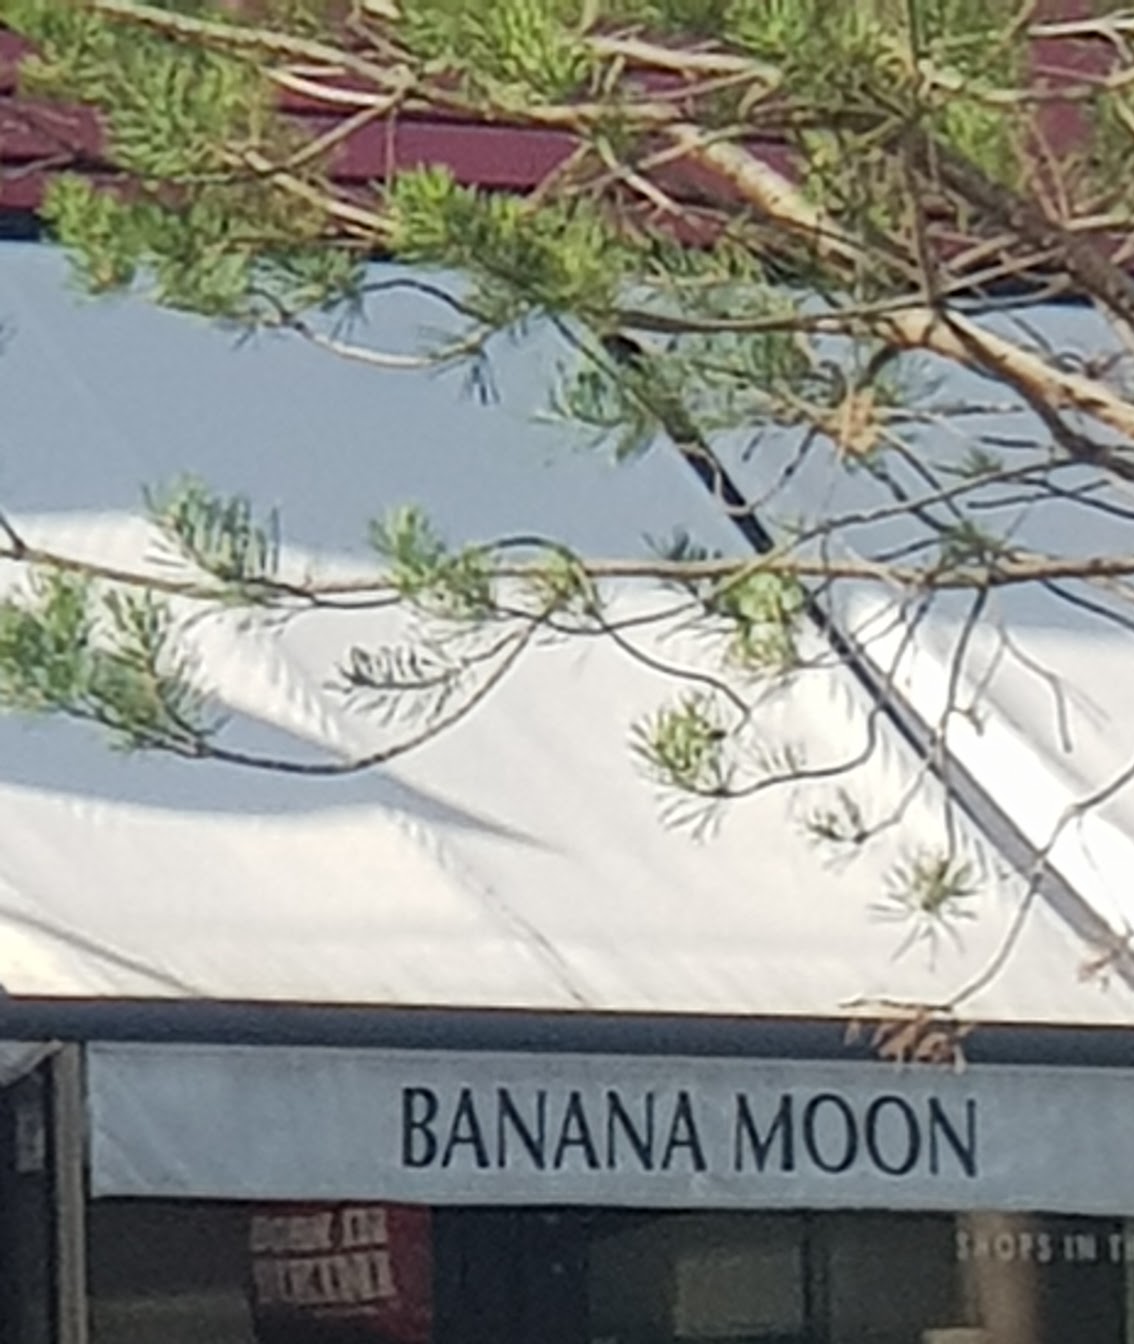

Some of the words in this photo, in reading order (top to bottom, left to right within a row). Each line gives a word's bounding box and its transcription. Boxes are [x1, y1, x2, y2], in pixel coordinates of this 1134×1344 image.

[401, 1086, 707, 1172] BANANA
[733, 1093, 978, 1177] MOON
[955, 1231, 1053, 1263] SHOPS
[1063, 1233, 1097, 1261] IN
